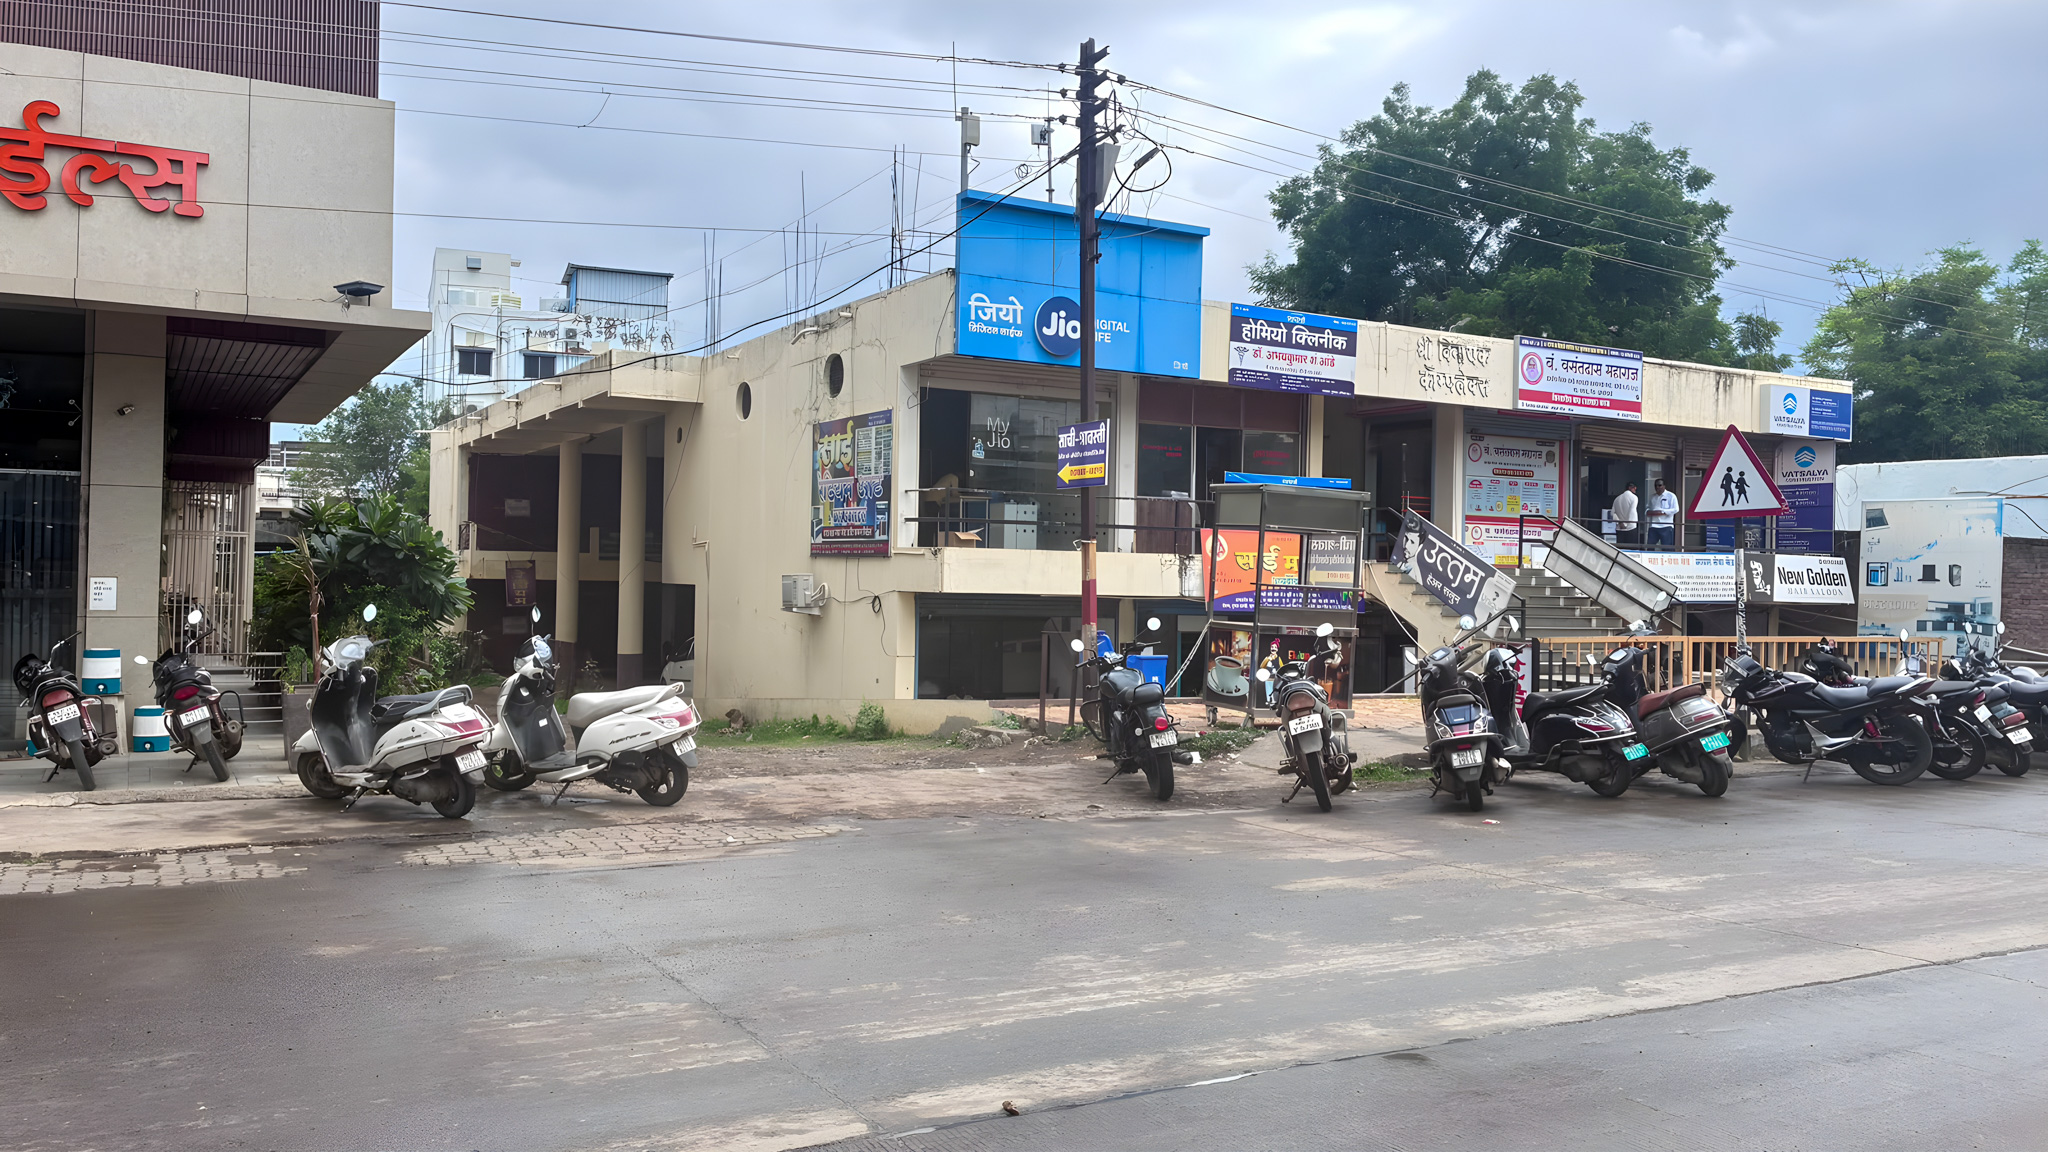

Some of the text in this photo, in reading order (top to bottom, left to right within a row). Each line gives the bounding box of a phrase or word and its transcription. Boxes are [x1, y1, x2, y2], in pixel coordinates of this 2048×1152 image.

[968, 293, 1024, 324] जियो
[1042, 310, 1081, 340] Jio
[1095, 319, 1130, 333] IGITAL
[1241, 318, 1288, 343] होमियो
[1291, 325, 1348, 350] क्लिनीक
[1095, 331, 1112, 343] IFE
[987, 416, 1010, 437] My
[987, 432, 1011, 449] Jio
[1781, 470, 1829, 479] VATSALYA
[1777, 566, 1848, 587] New Golden
